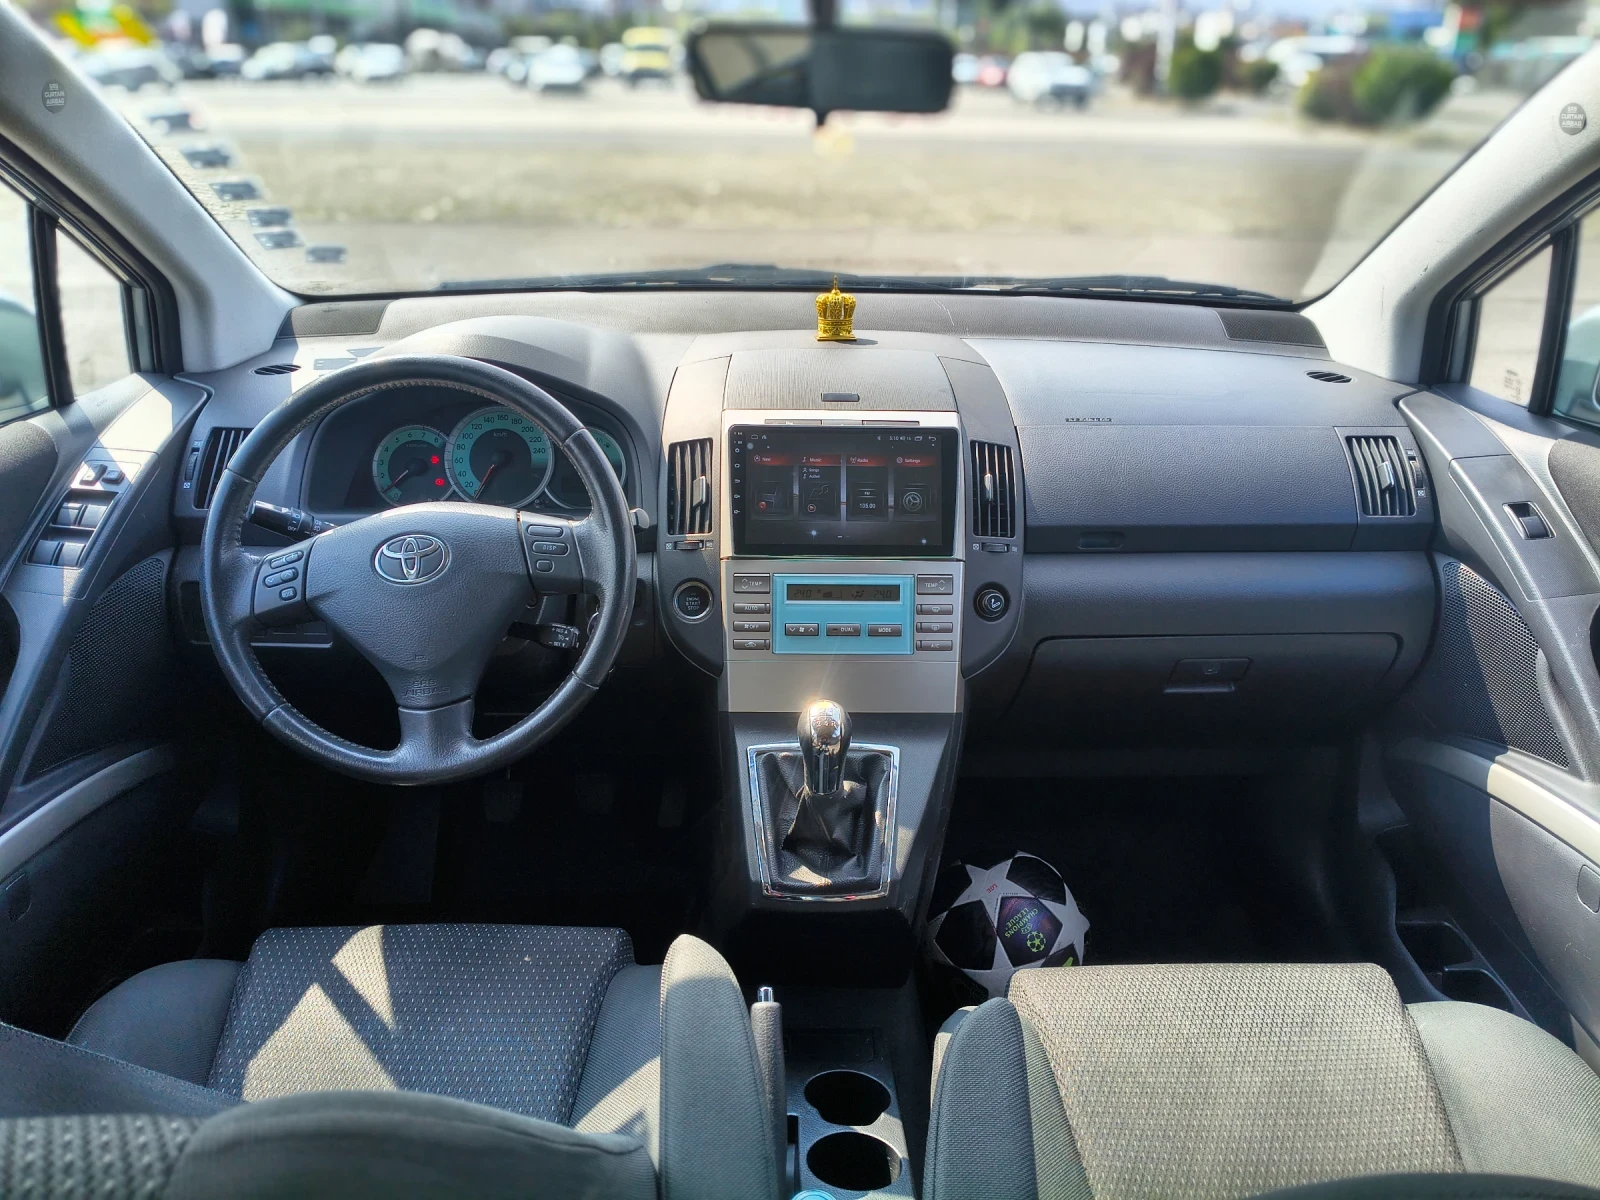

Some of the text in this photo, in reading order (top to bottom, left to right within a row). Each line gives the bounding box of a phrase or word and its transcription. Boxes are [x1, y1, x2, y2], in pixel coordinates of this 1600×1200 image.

[483, 416, 495, 424] 140
[1004, 908, 1038, 938] CHAMPIONS
[1005, 907, 1029, 928] LEAGUE
